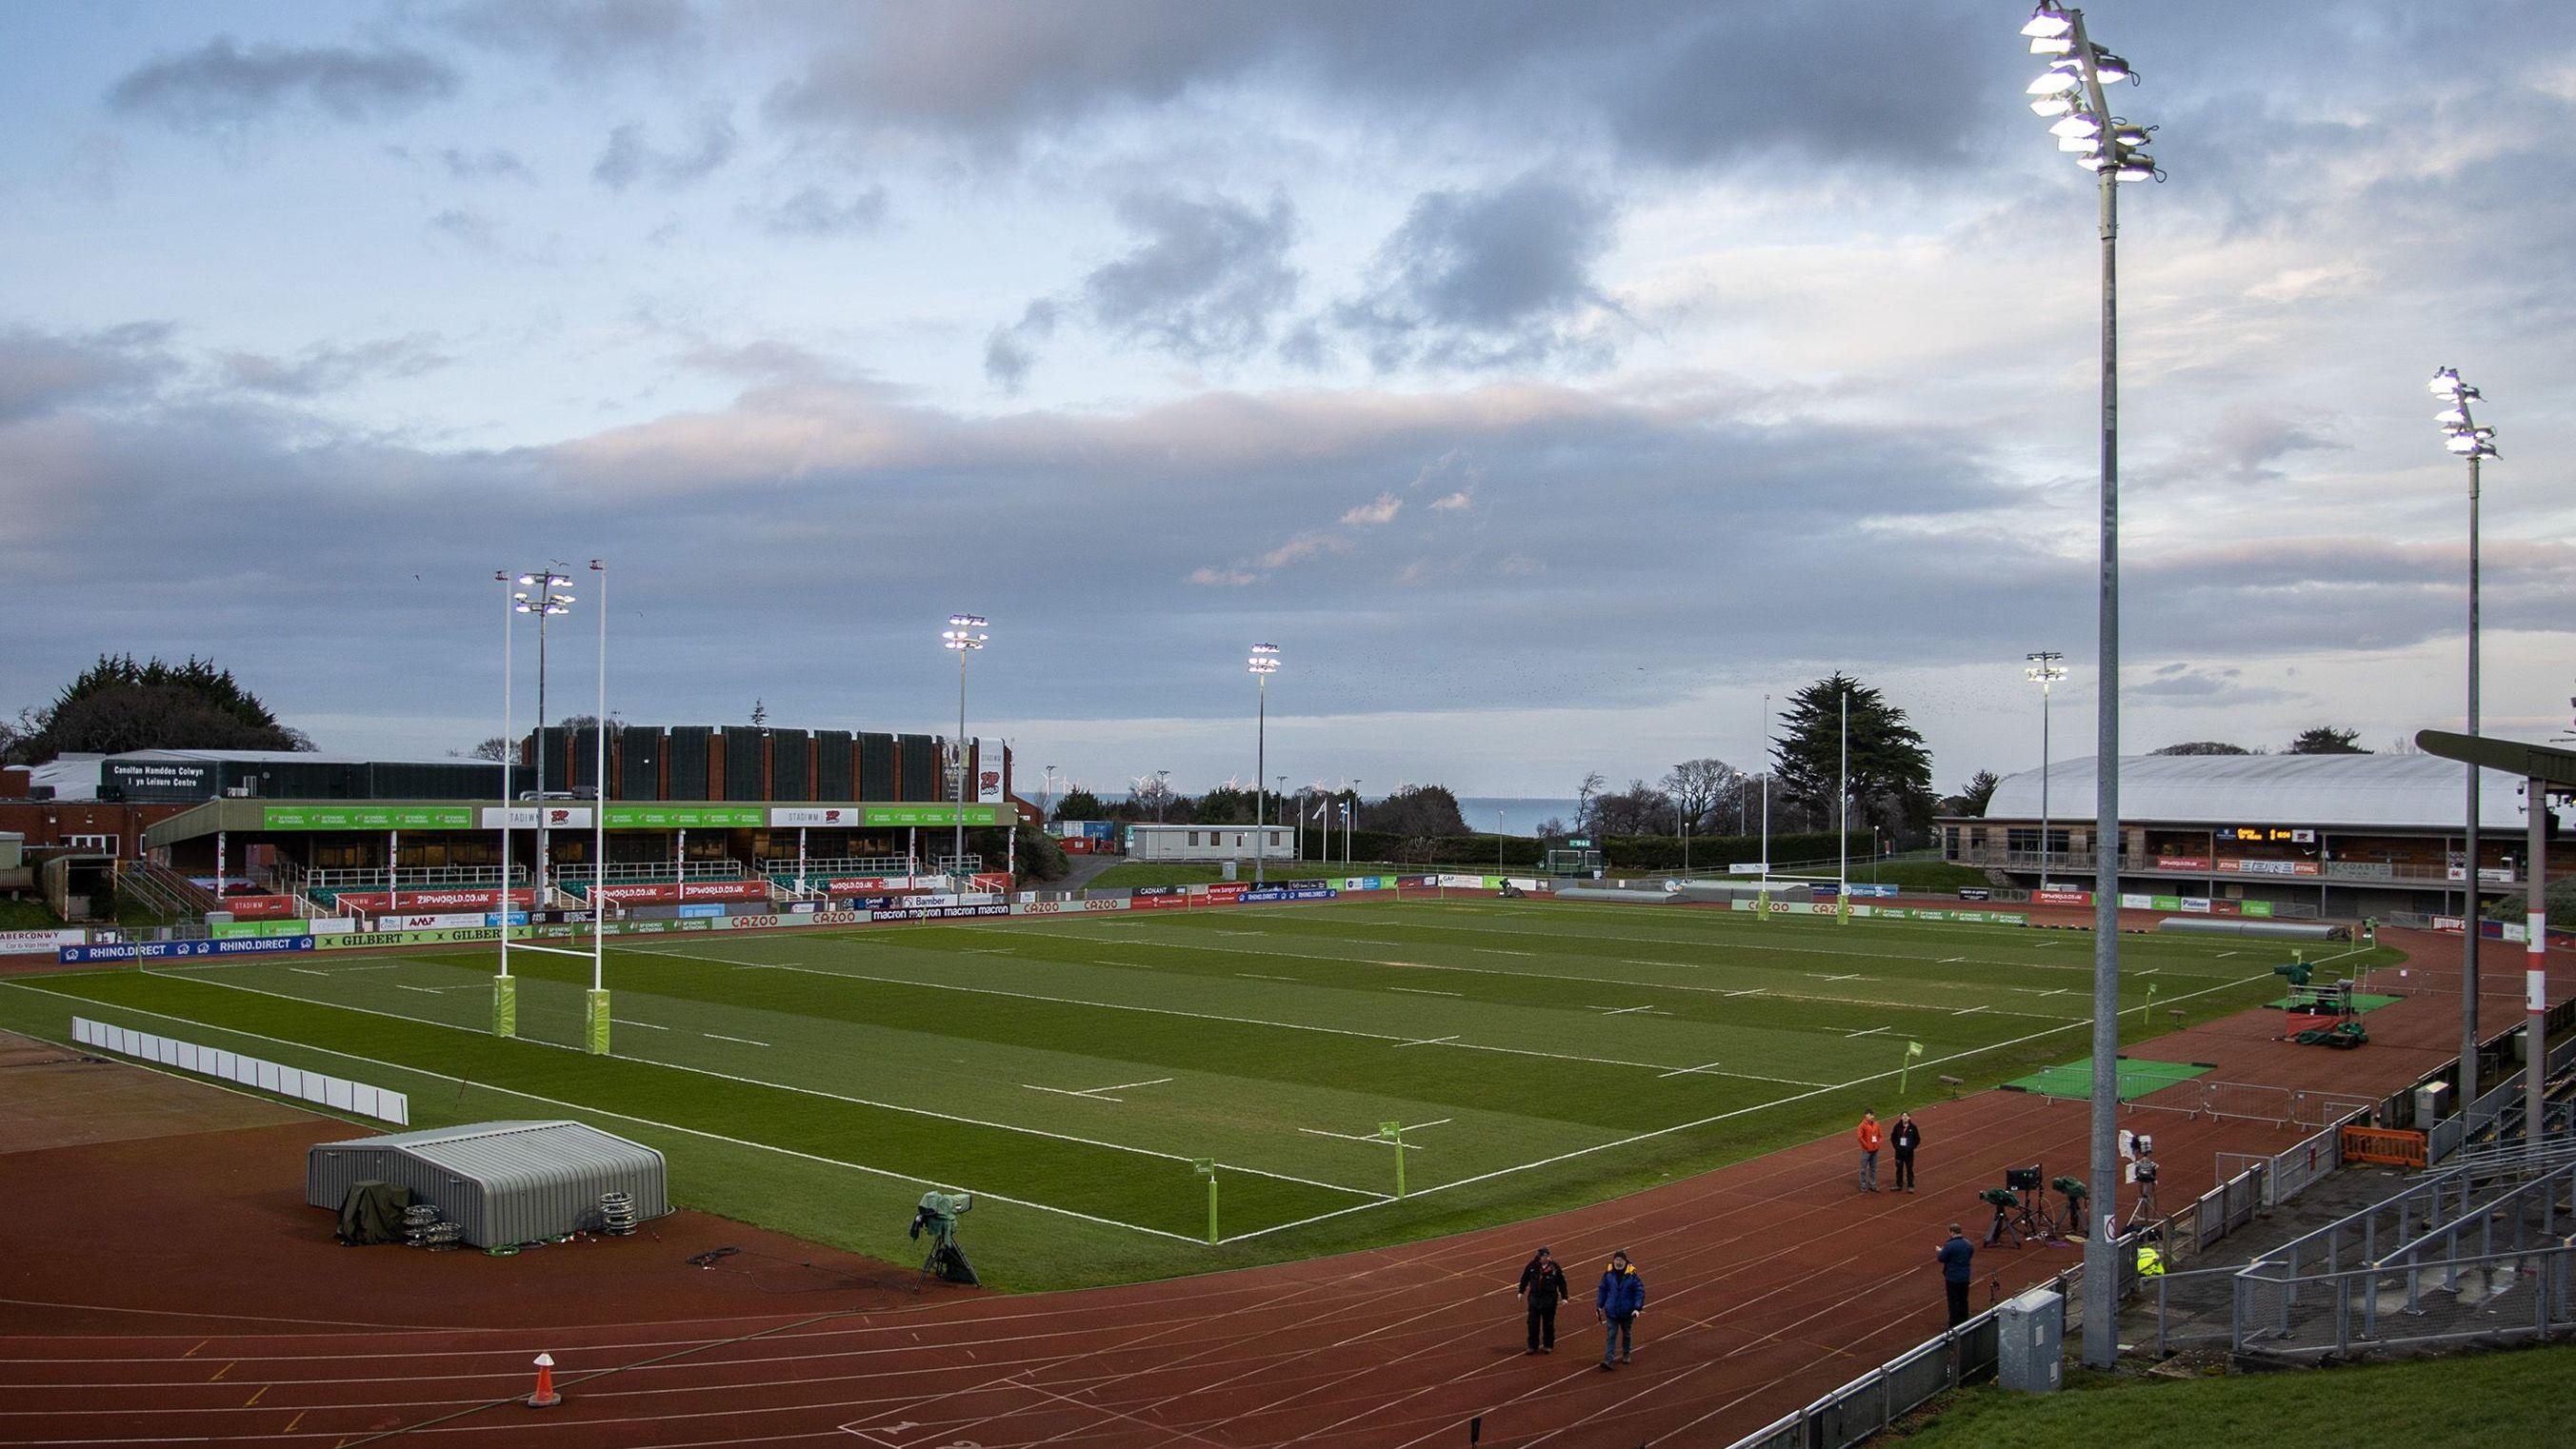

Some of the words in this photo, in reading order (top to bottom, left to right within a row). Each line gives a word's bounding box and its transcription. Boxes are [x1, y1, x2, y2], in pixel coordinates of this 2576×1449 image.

[114, 765, 143, 775] Canolfan
[145, 766, 176, 776] Hamdden
[178, 766, 205, 778] Colwyn
[147, 778, 171, 786] Leisure
[173, 778, 197, 787] Centre
[685, 885, 745, 896] ZIPWORLD.CO.UK
[416, 893, 489, 904] ZIPWORLD.CO.UK
[915, 896, 945, 906] Bamber
[977, 905, 1008, 915] macron
[1024, 903, 1059, 913] CAZOO
[1084, 900, 1118, 910] CAZOO
[1811, 904, 1855, 915] CAZO
[812, 912, 855, 923] CAZOO
[873, 909, 907, 920] macron
[944, 907, 976, 917] macron
[731, 915, 778, 928] CAZOO
[0, 931, 59, 941] ABERCONWY
[342, 933, 404, 946] GILBERT
[219, 939, 291, 952] RHINO.DIRECT
[90, 944, 167, 959] RHINO.DIRECT
